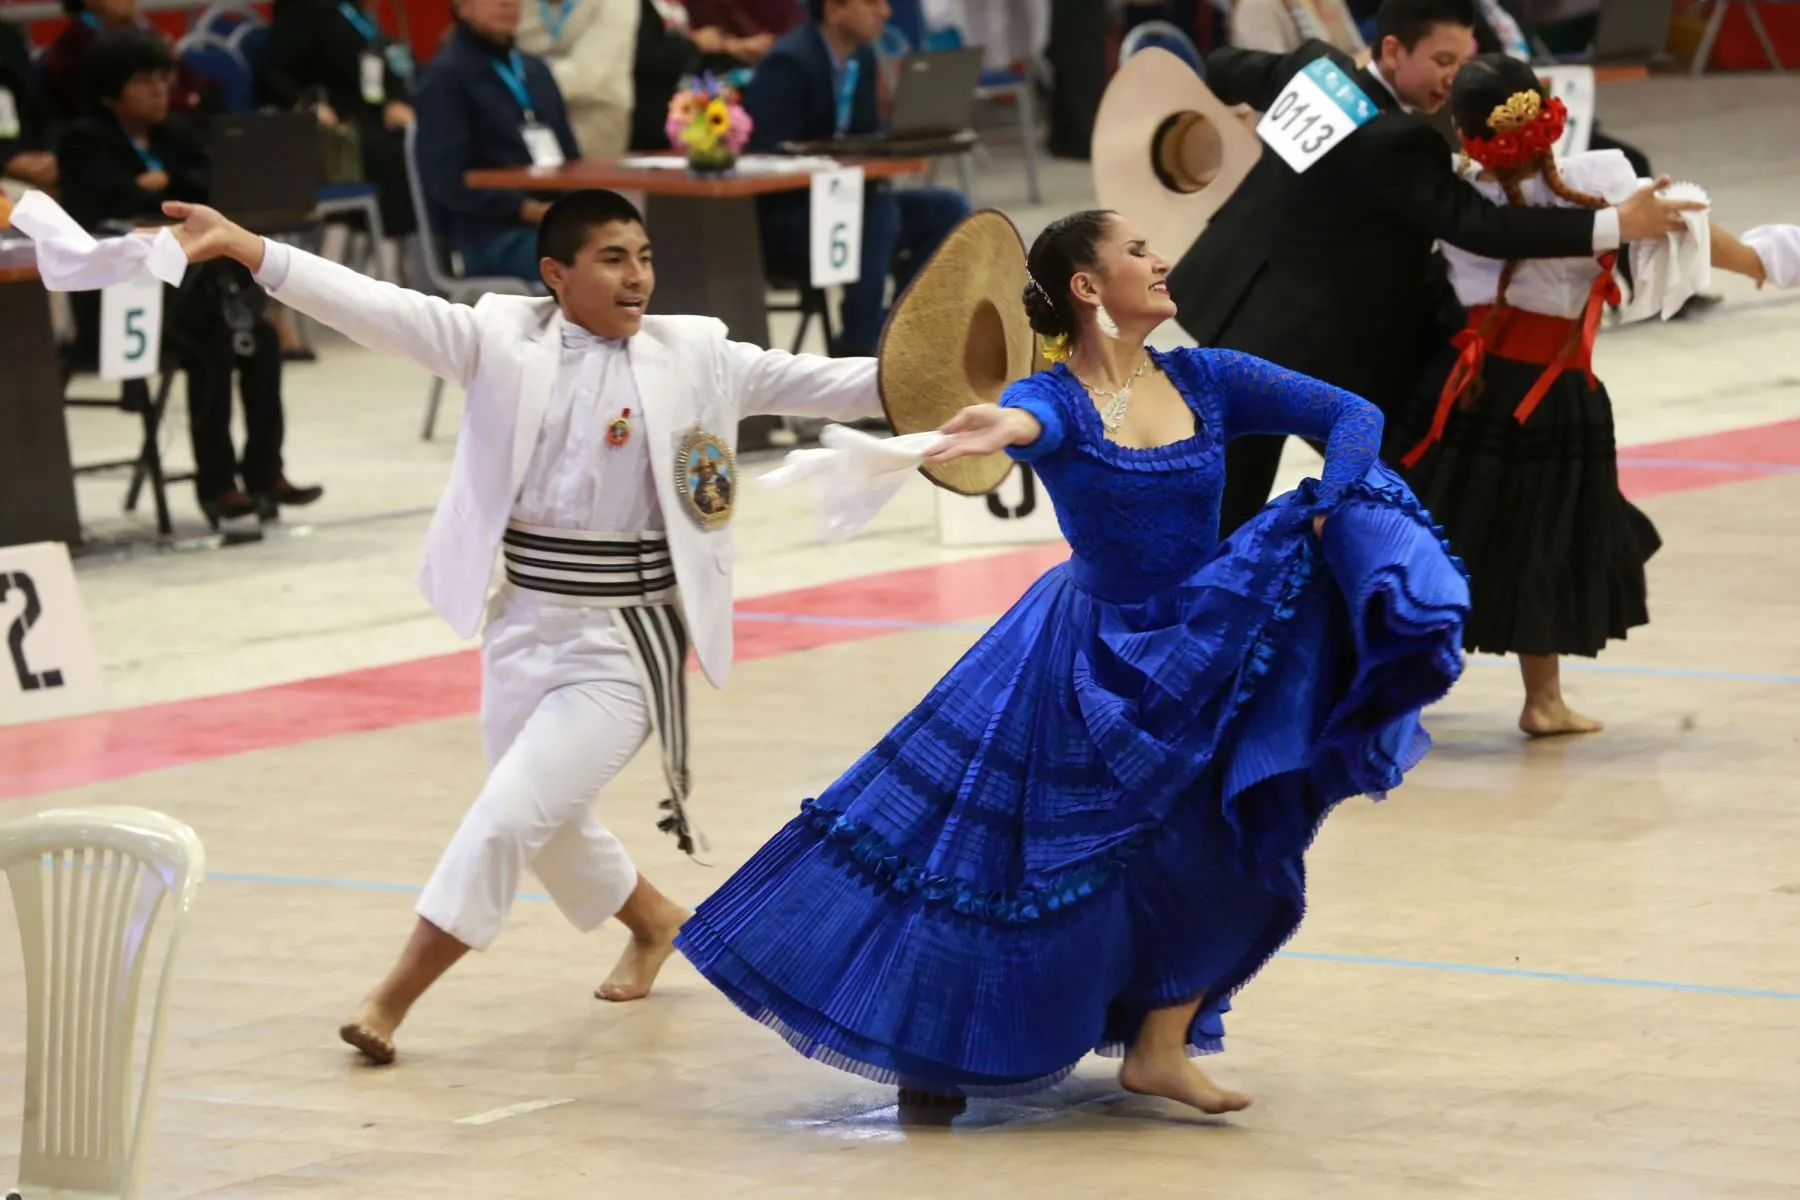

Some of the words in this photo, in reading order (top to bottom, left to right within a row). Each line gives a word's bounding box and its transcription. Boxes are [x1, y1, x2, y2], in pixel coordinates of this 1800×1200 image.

[1271, 91, 1334, 153] 0113
[829, 222, 849, 269] 6
[125, 309, 147, 360] 5
[0, 570, 64, 691] 2
